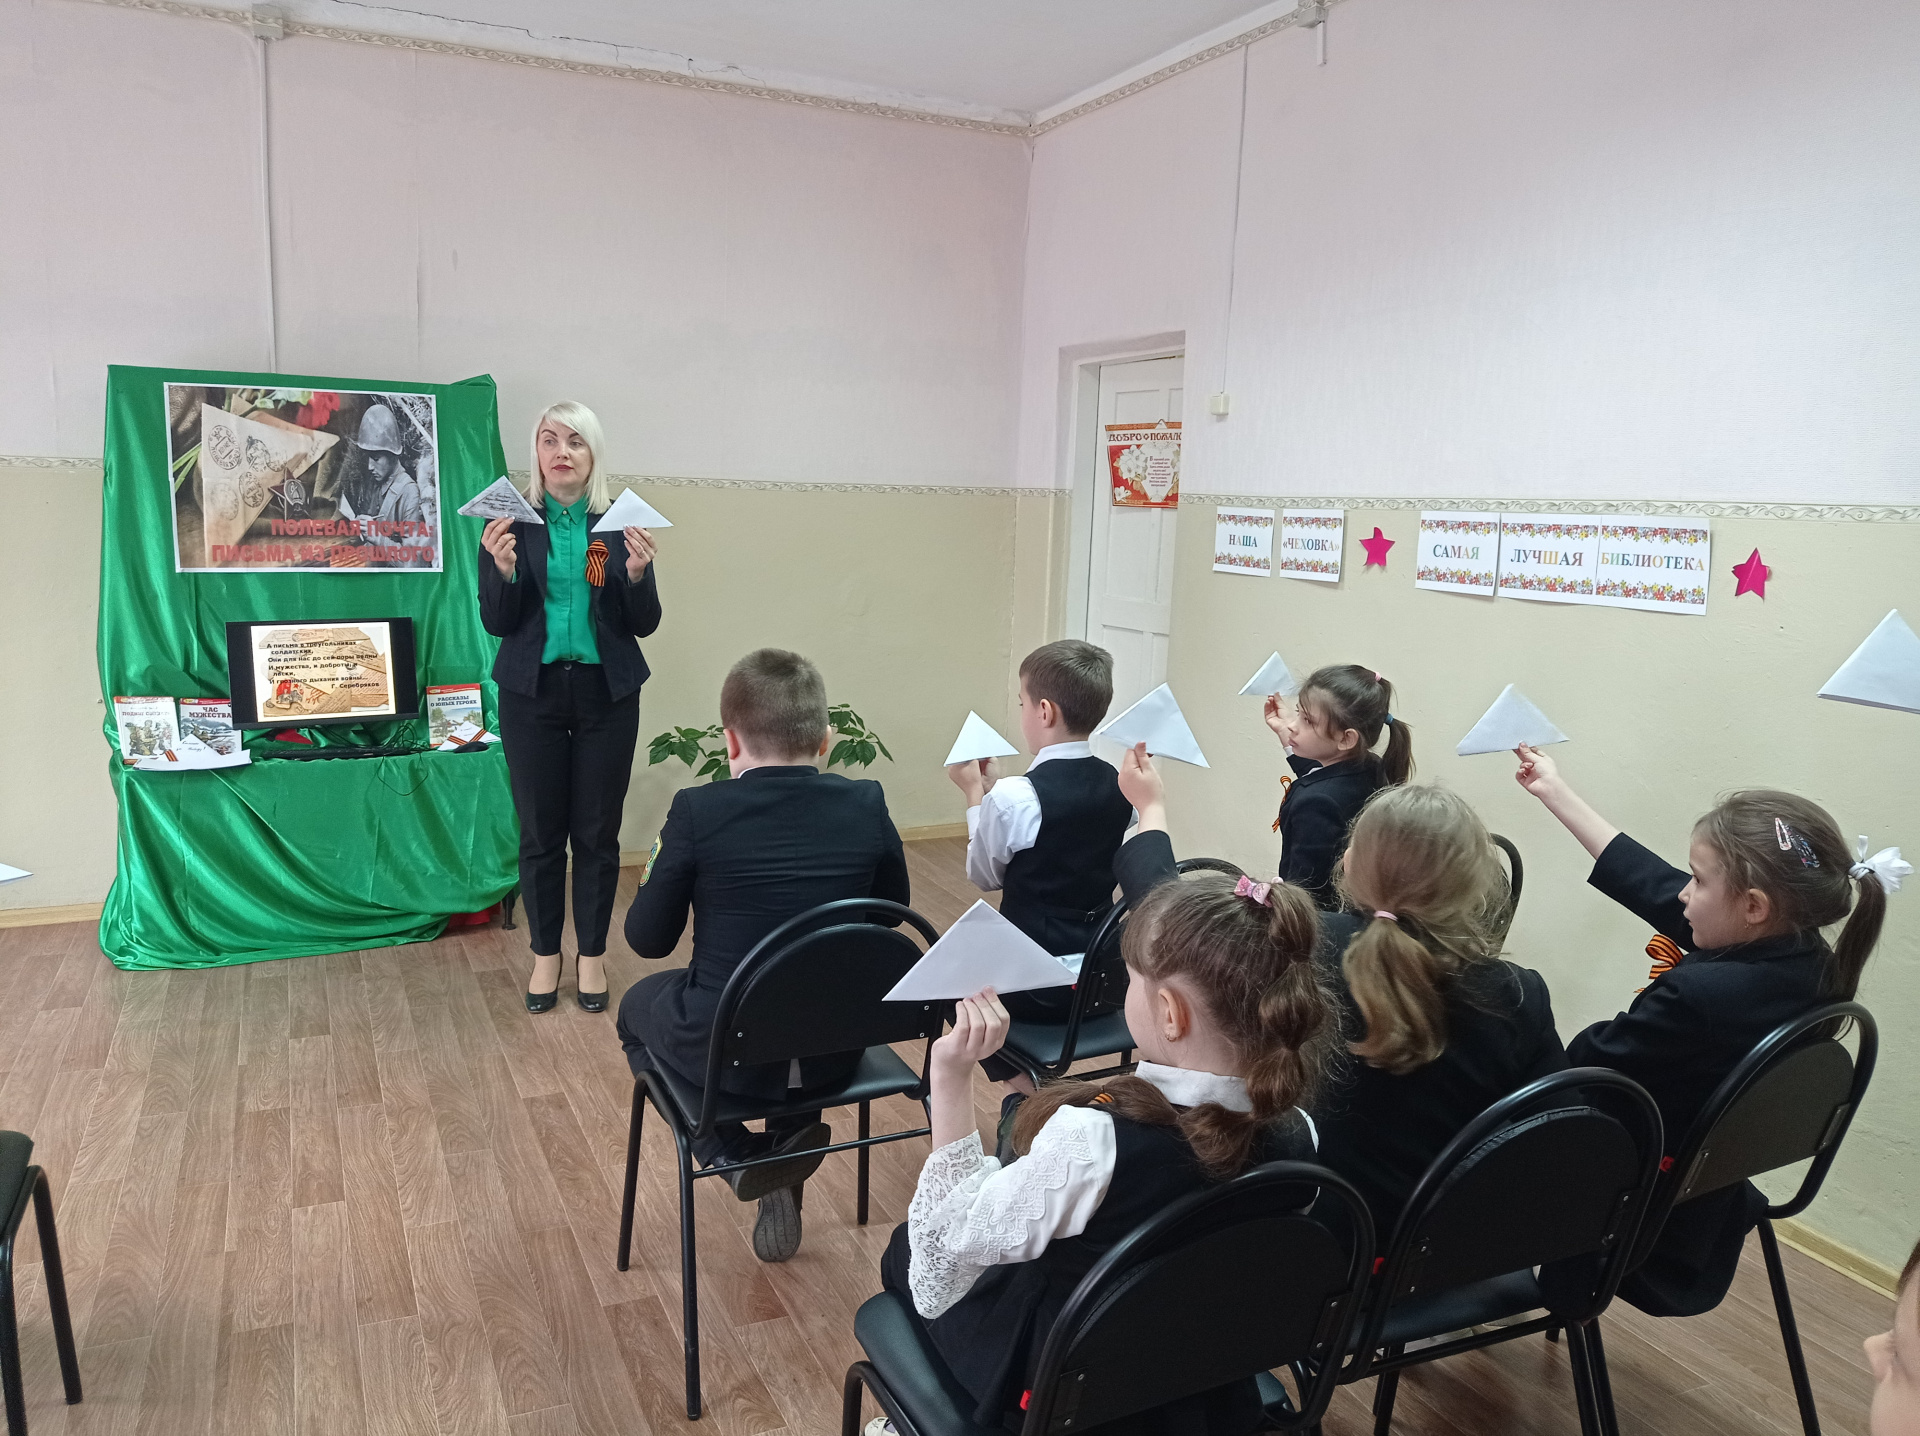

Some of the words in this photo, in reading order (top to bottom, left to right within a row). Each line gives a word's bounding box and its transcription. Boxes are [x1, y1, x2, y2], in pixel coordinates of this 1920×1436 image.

[1109, 433, 1142, 442] ДОБРО
[271, 519, 361, 536] ПОЛЕВАЯ
[367, 520, 434, 537] ПОЧТА:
[212, 545, 295, 562] ПИСЬМА
[300, 545, 325, 562] ИЗ
[331, 545, 435, 562] ПРОШЛОГО
[1228, 534, 1258, 547] НАША
[1282, 538, 1339, 552] «ЧЕХОВКА»
[1433, 544, 1480, 560] САМАЯ
[1510, 549, 1583, 567] ЛУЧШАЯ
[1601, 553, 1705, 571] БИБЛИОТЕКА
